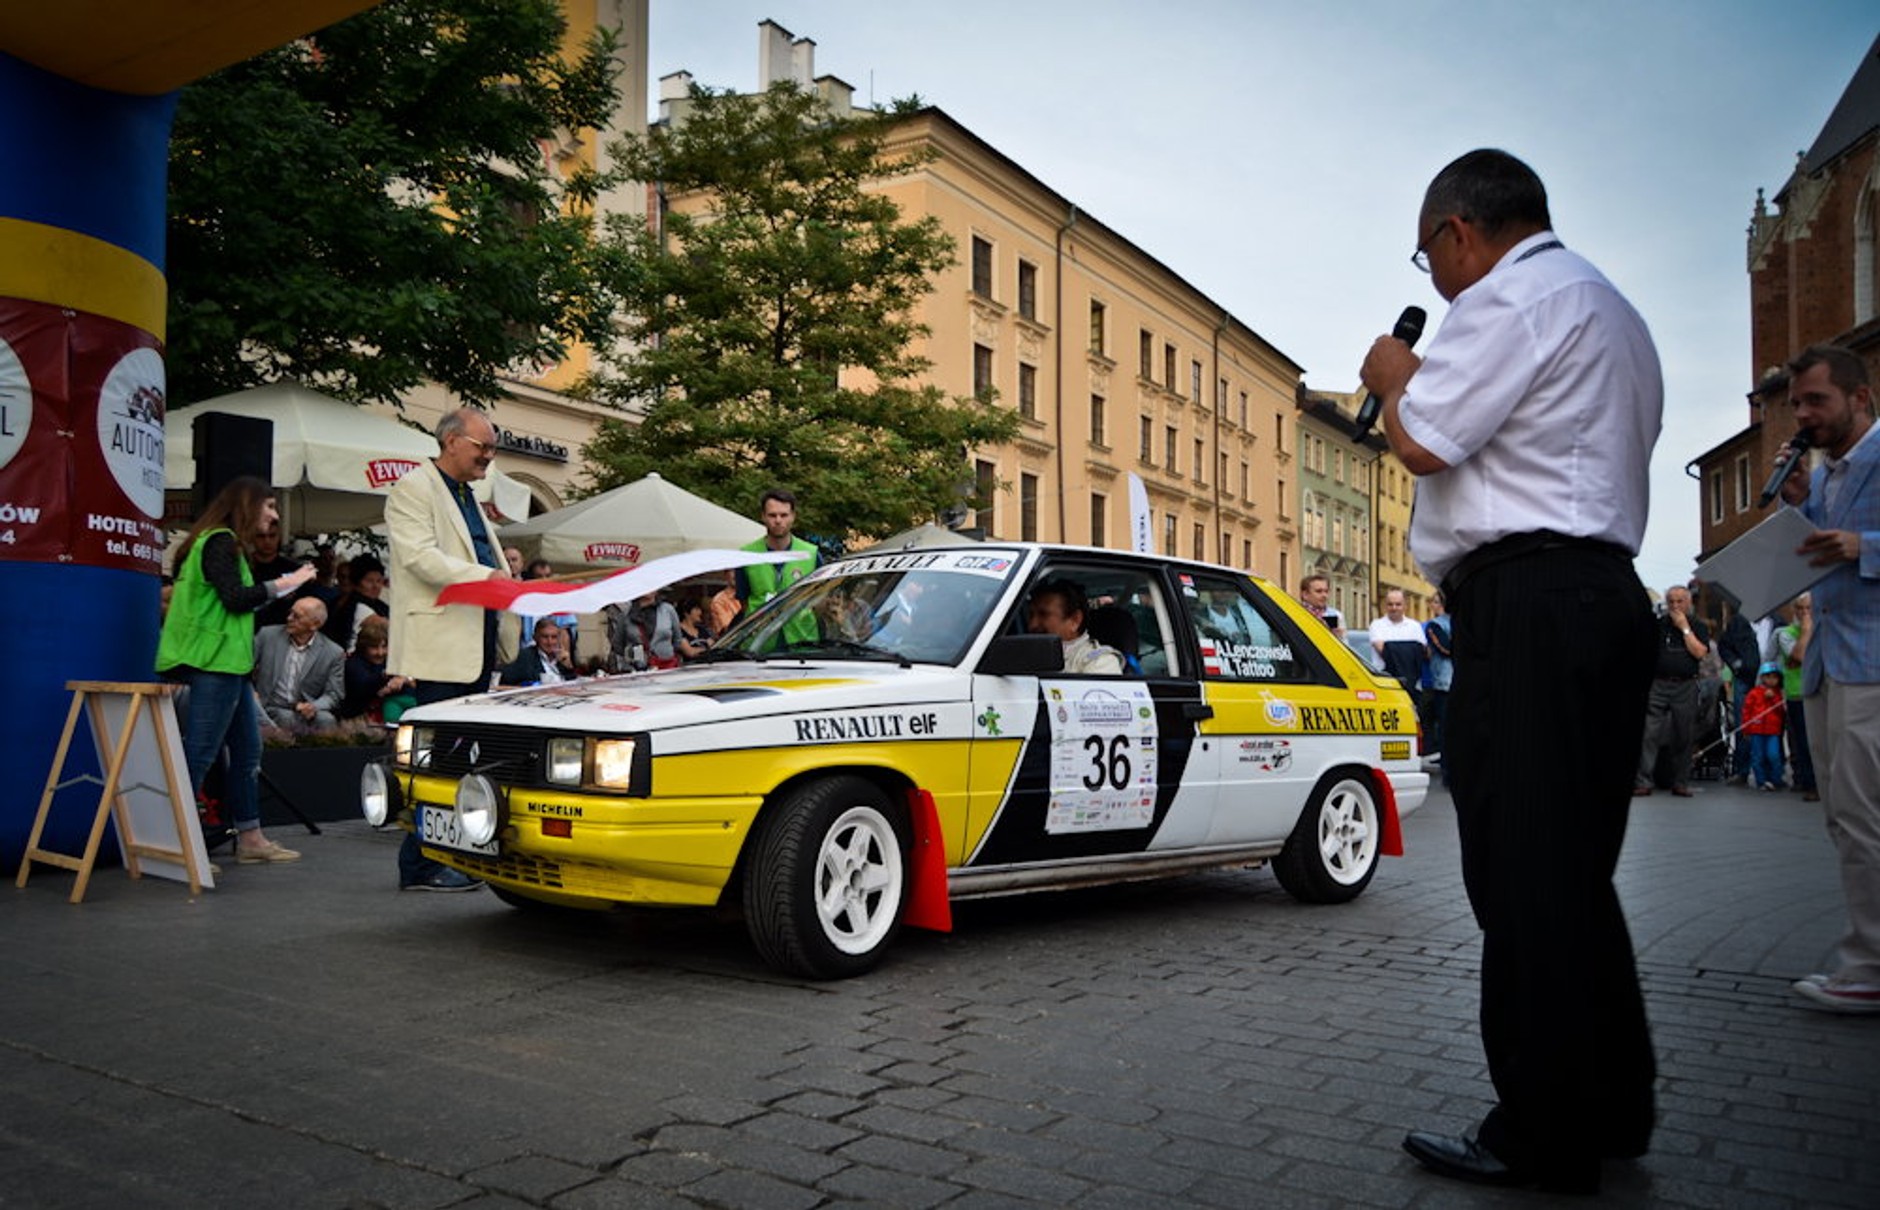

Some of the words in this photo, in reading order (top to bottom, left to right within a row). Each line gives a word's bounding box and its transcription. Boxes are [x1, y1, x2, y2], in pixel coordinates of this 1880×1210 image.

[504, 430, 532, 450] Bank
[106, 539, 131, 556] tel.
[1232, 659, 1276, 678] Tattoo
[794, 715, 904, 741] RENAULT
[910, 713, 937, 735] elf
[1300, 707, 1377, 731] RENAULT
[1381, 708, 1400, 731] elf
[1082, 734, 1131, 792] 36
[528, 802, 583, 817] MICHELIN
